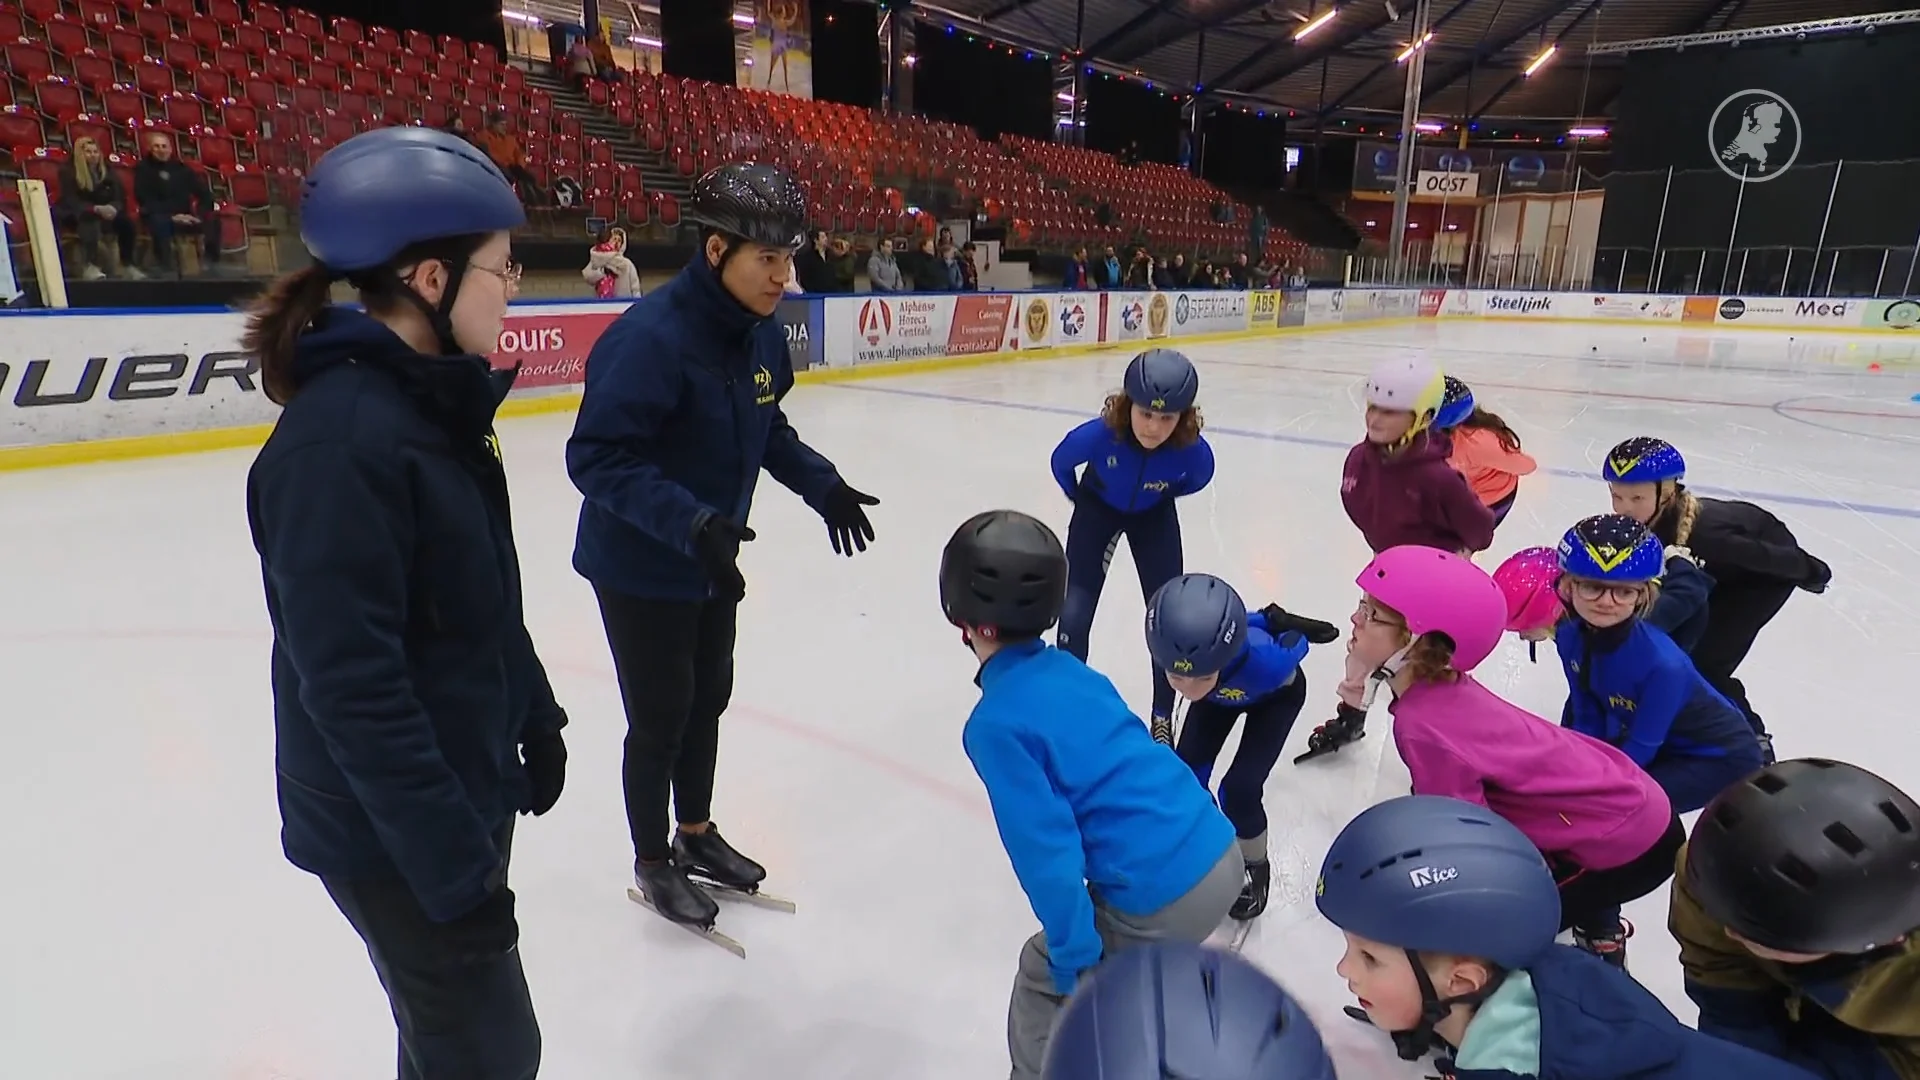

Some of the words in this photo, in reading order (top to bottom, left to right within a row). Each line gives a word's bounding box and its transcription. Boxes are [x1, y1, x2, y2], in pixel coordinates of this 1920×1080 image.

[1426, 176, 1468, 192] OOST
[899, 302, 936, 315] Alphense
[1254, 293, 1275, 313] ABS
[899, 314, 927, 326] Horeca
[493, 327, 564, 354] ours
[783, 322, 809, 341] DIA
[898, 325, 931, 338] Centrale
[518, 357, 585, 379] soonlijk
[0, 350, 262, 408] UER
